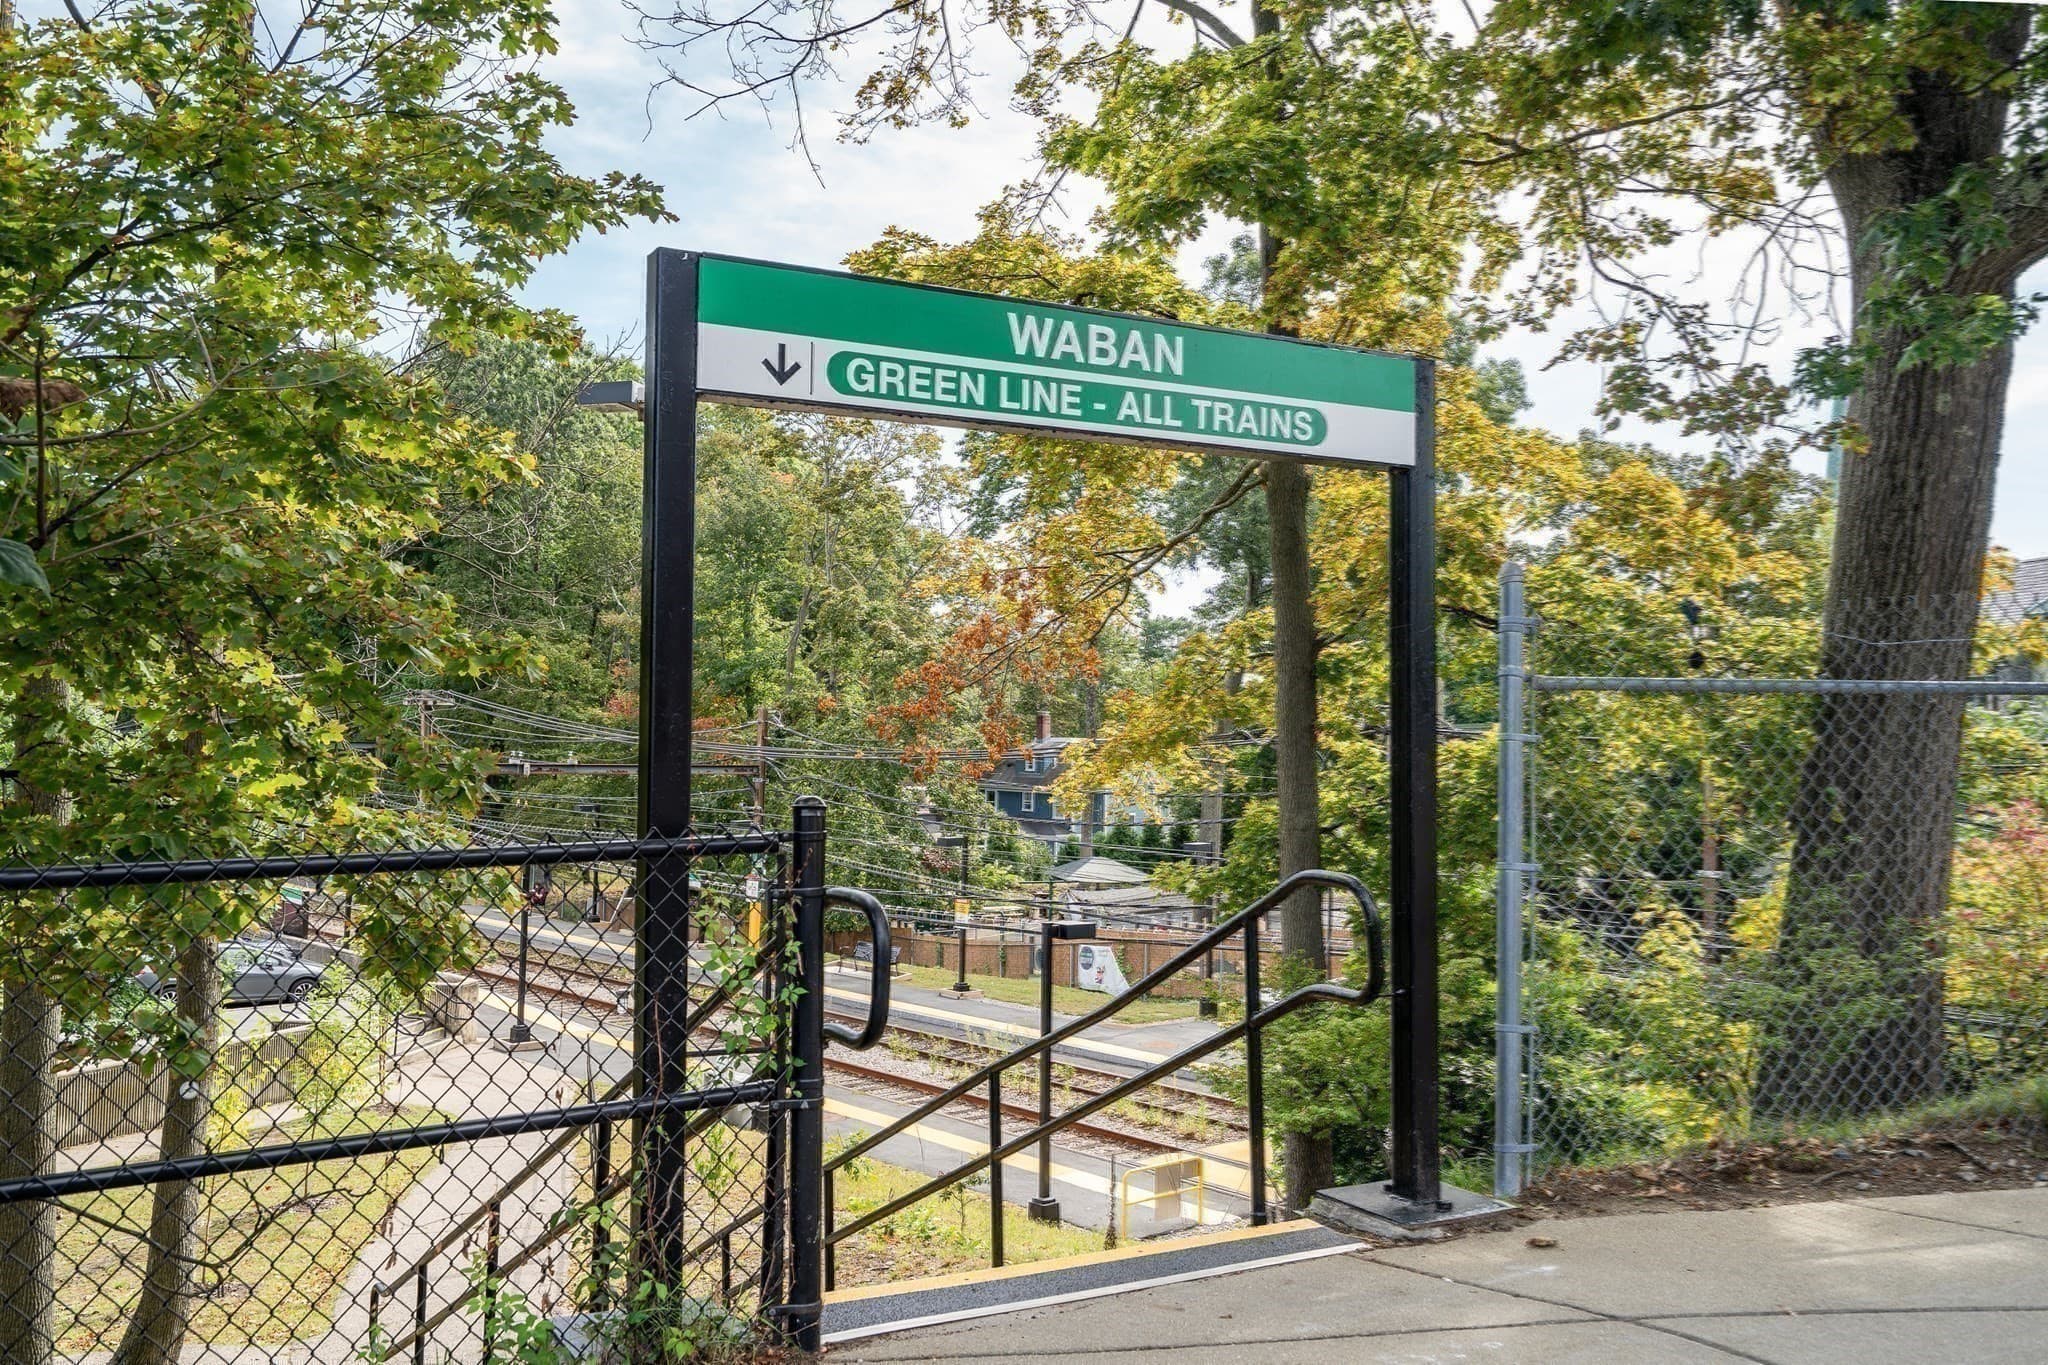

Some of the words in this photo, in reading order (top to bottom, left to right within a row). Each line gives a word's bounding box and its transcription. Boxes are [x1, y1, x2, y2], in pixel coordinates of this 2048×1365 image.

[1007, 312, 1184, 376] WABAN
[846, 357, 985, 406] GREEN
[1000, 376, 1082, 417] LINE
[1116, 391, 1183, 428] ALL
[1191, 398, 1313, 442] TRAINS
